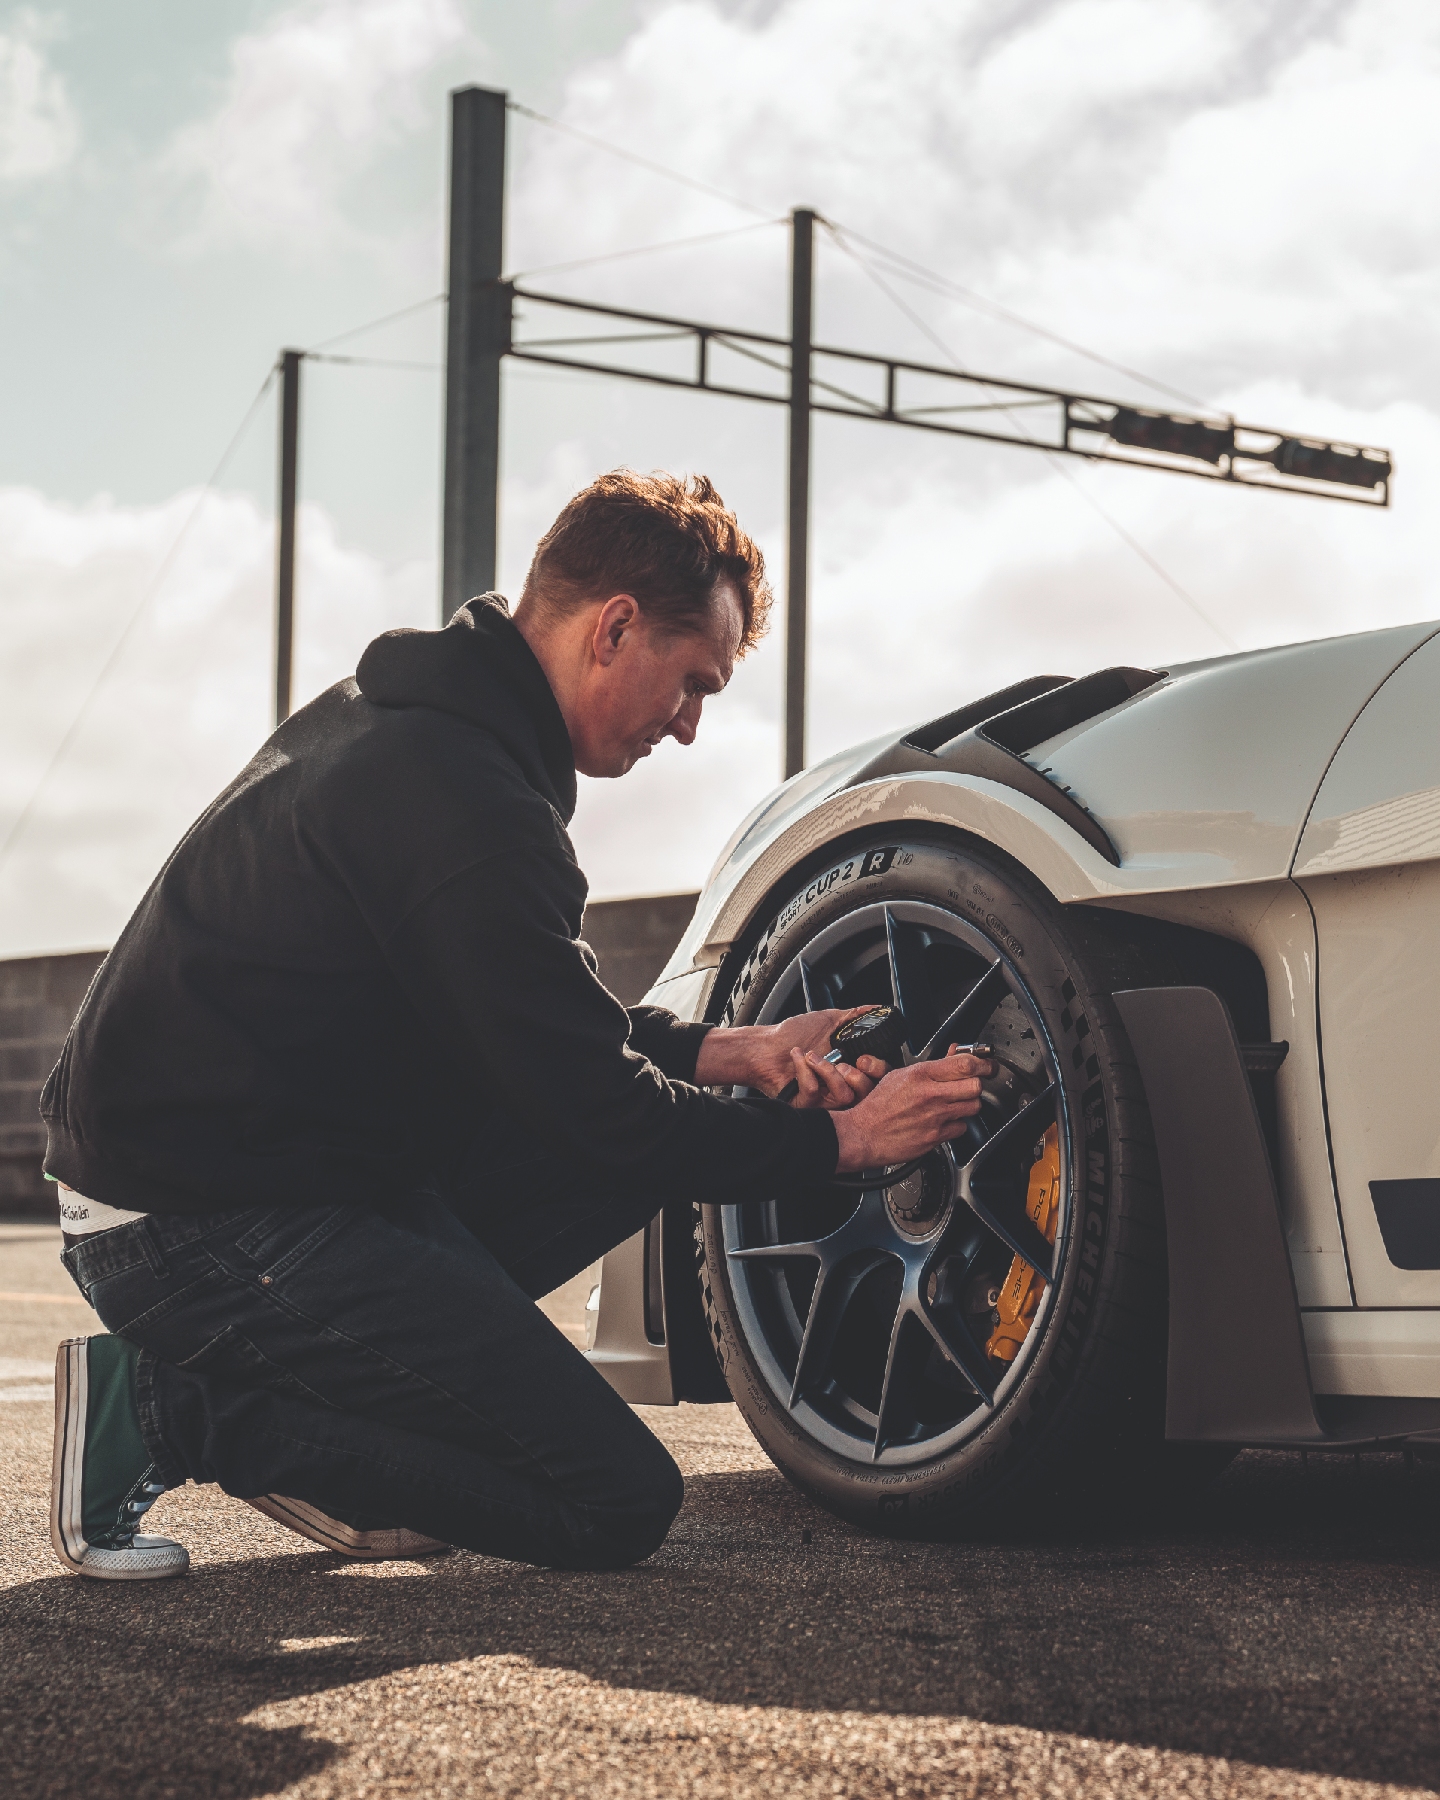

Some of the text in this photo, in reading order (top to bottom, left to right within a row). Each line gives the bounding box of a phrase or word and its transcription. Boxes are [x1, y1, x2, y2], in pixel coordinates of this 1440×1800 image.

[805, 868, 840, 904] CUP
[841, 861, 854, 881] 2
[868, 852, 885, 872] R
[780, 894, 804, 922] PILOT
[780, 907, 801, 930] SPORT
[1054, 1150, 1106, 1371] MICHELIN
[884, 1500, 904, 1514] 20
